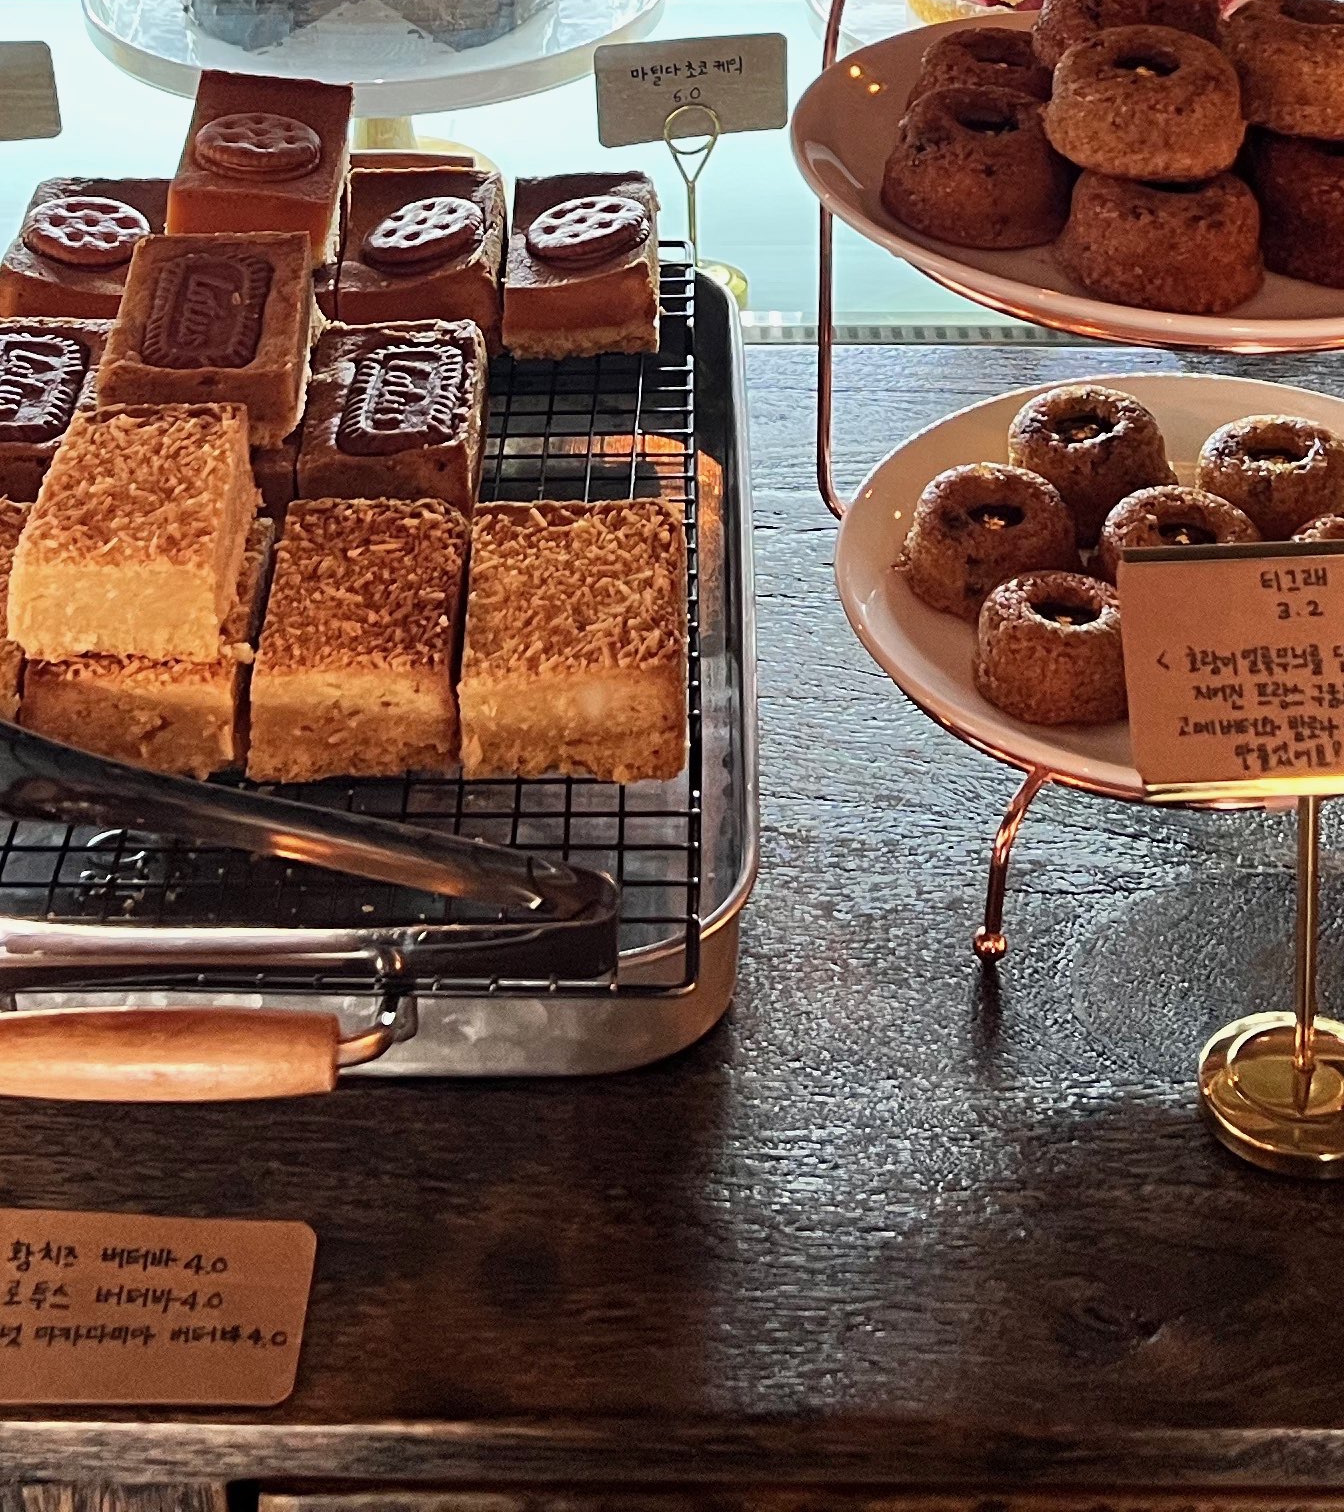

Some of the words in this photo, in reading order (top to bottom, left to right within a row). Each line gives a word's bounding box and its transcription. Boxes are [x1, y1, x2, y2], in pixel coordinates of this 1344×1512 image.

[630, 64, 682, 87] 마틸다
[685, 60, 710, 79] 초코
[713, 55, 743, 75] 케익
[673, 87, 701, 103] 6.0
[1259, 567, 1328, 593] 티그래
[1276, 600, 1324, 620] 3.2
[1186, 645, 1239, 677] 호랑이
[1192, 683, 1245, 711] 지어진
[1255, 681, 1306, 710] 프랑스
[7, 1238, 79, 1273] 황치즈
[100, 1247, 178, 1273] 버터바
[2, 1278, 71, 1311] 로투스
[32, 1322, 157, 1349] 마카다미아
